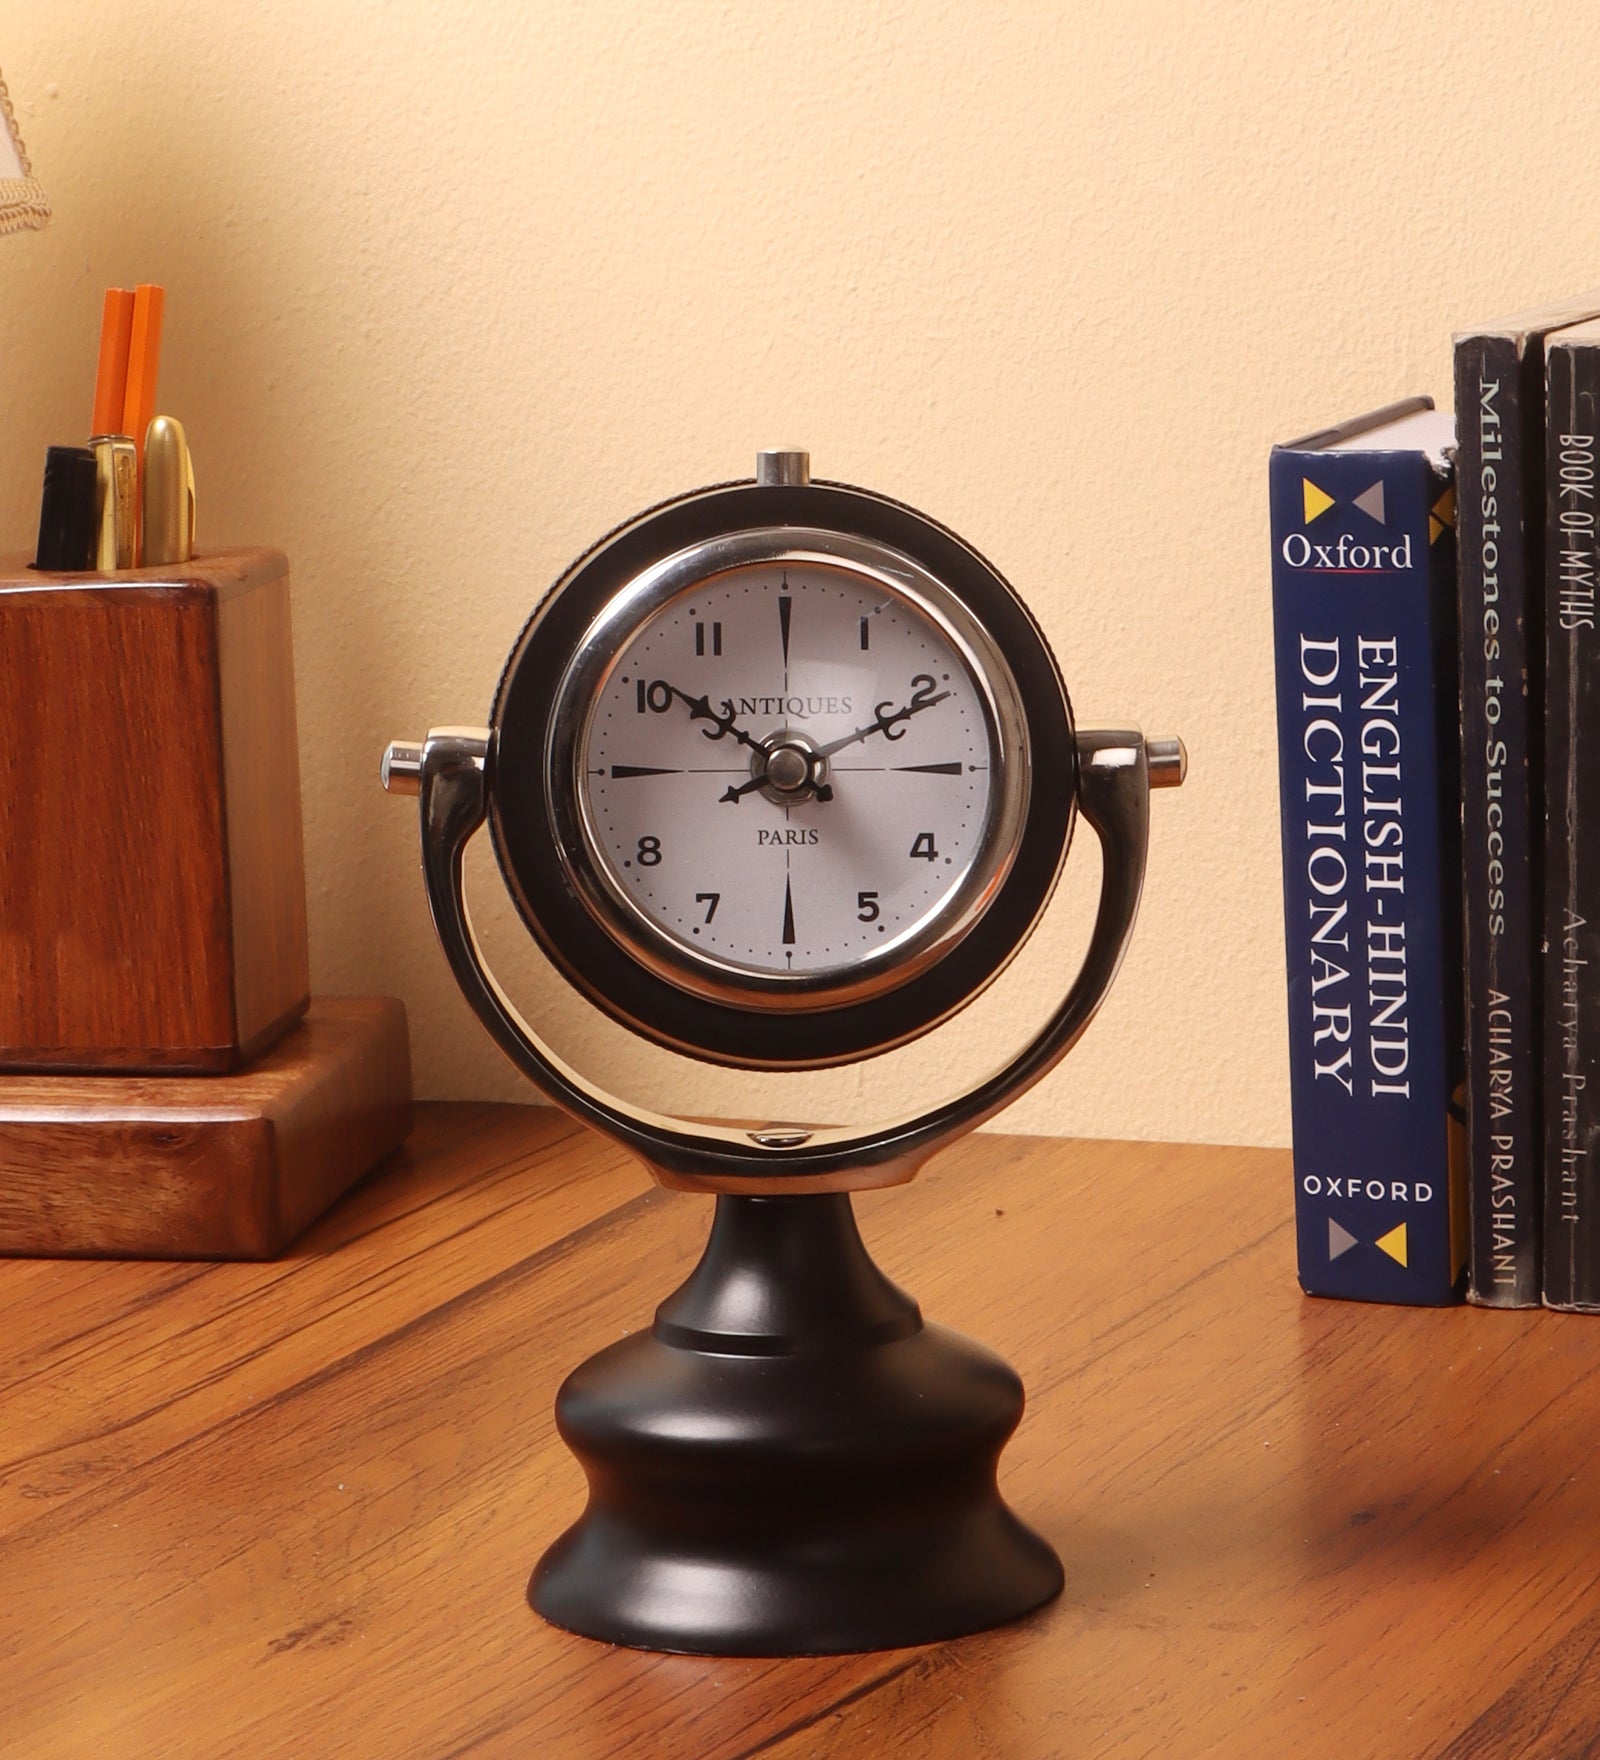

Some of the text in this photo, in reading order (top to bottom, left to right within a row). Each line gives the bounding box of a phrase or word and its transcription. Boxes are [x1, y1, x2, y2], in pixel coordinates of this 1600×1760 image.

[1559, 434, 1596, 631] BOOK OF MYTHS
[1282, 533, 1413, 568] Oxford
[696, 622, 721, 656] 11
[1478, 380, 1507, 936] Milestones to Success
[637, 679, 671, 713] 10
[721, 696, 852, 718] ANTIQUES
[909, 674, 937, 708] 2
[637, 836, 662, 866] 8
[757, 829, 819, 846] PARIS
[909, 833, 938, 862] 4
[1300, 632, 1354, 1097] DICTIONARY
[1357, 635, 1410, 1099] ENGLISH-HINDI
[695, 893, 720, 924] 7
[857, 892, 879, 922] 5
[1557, 908, 1588, 1225] Acharya Prashant
[1488, 989, 1517, 1288] ACHARYA PRASHANT
[1303, 1175, 1433, 1202] OXFORD
